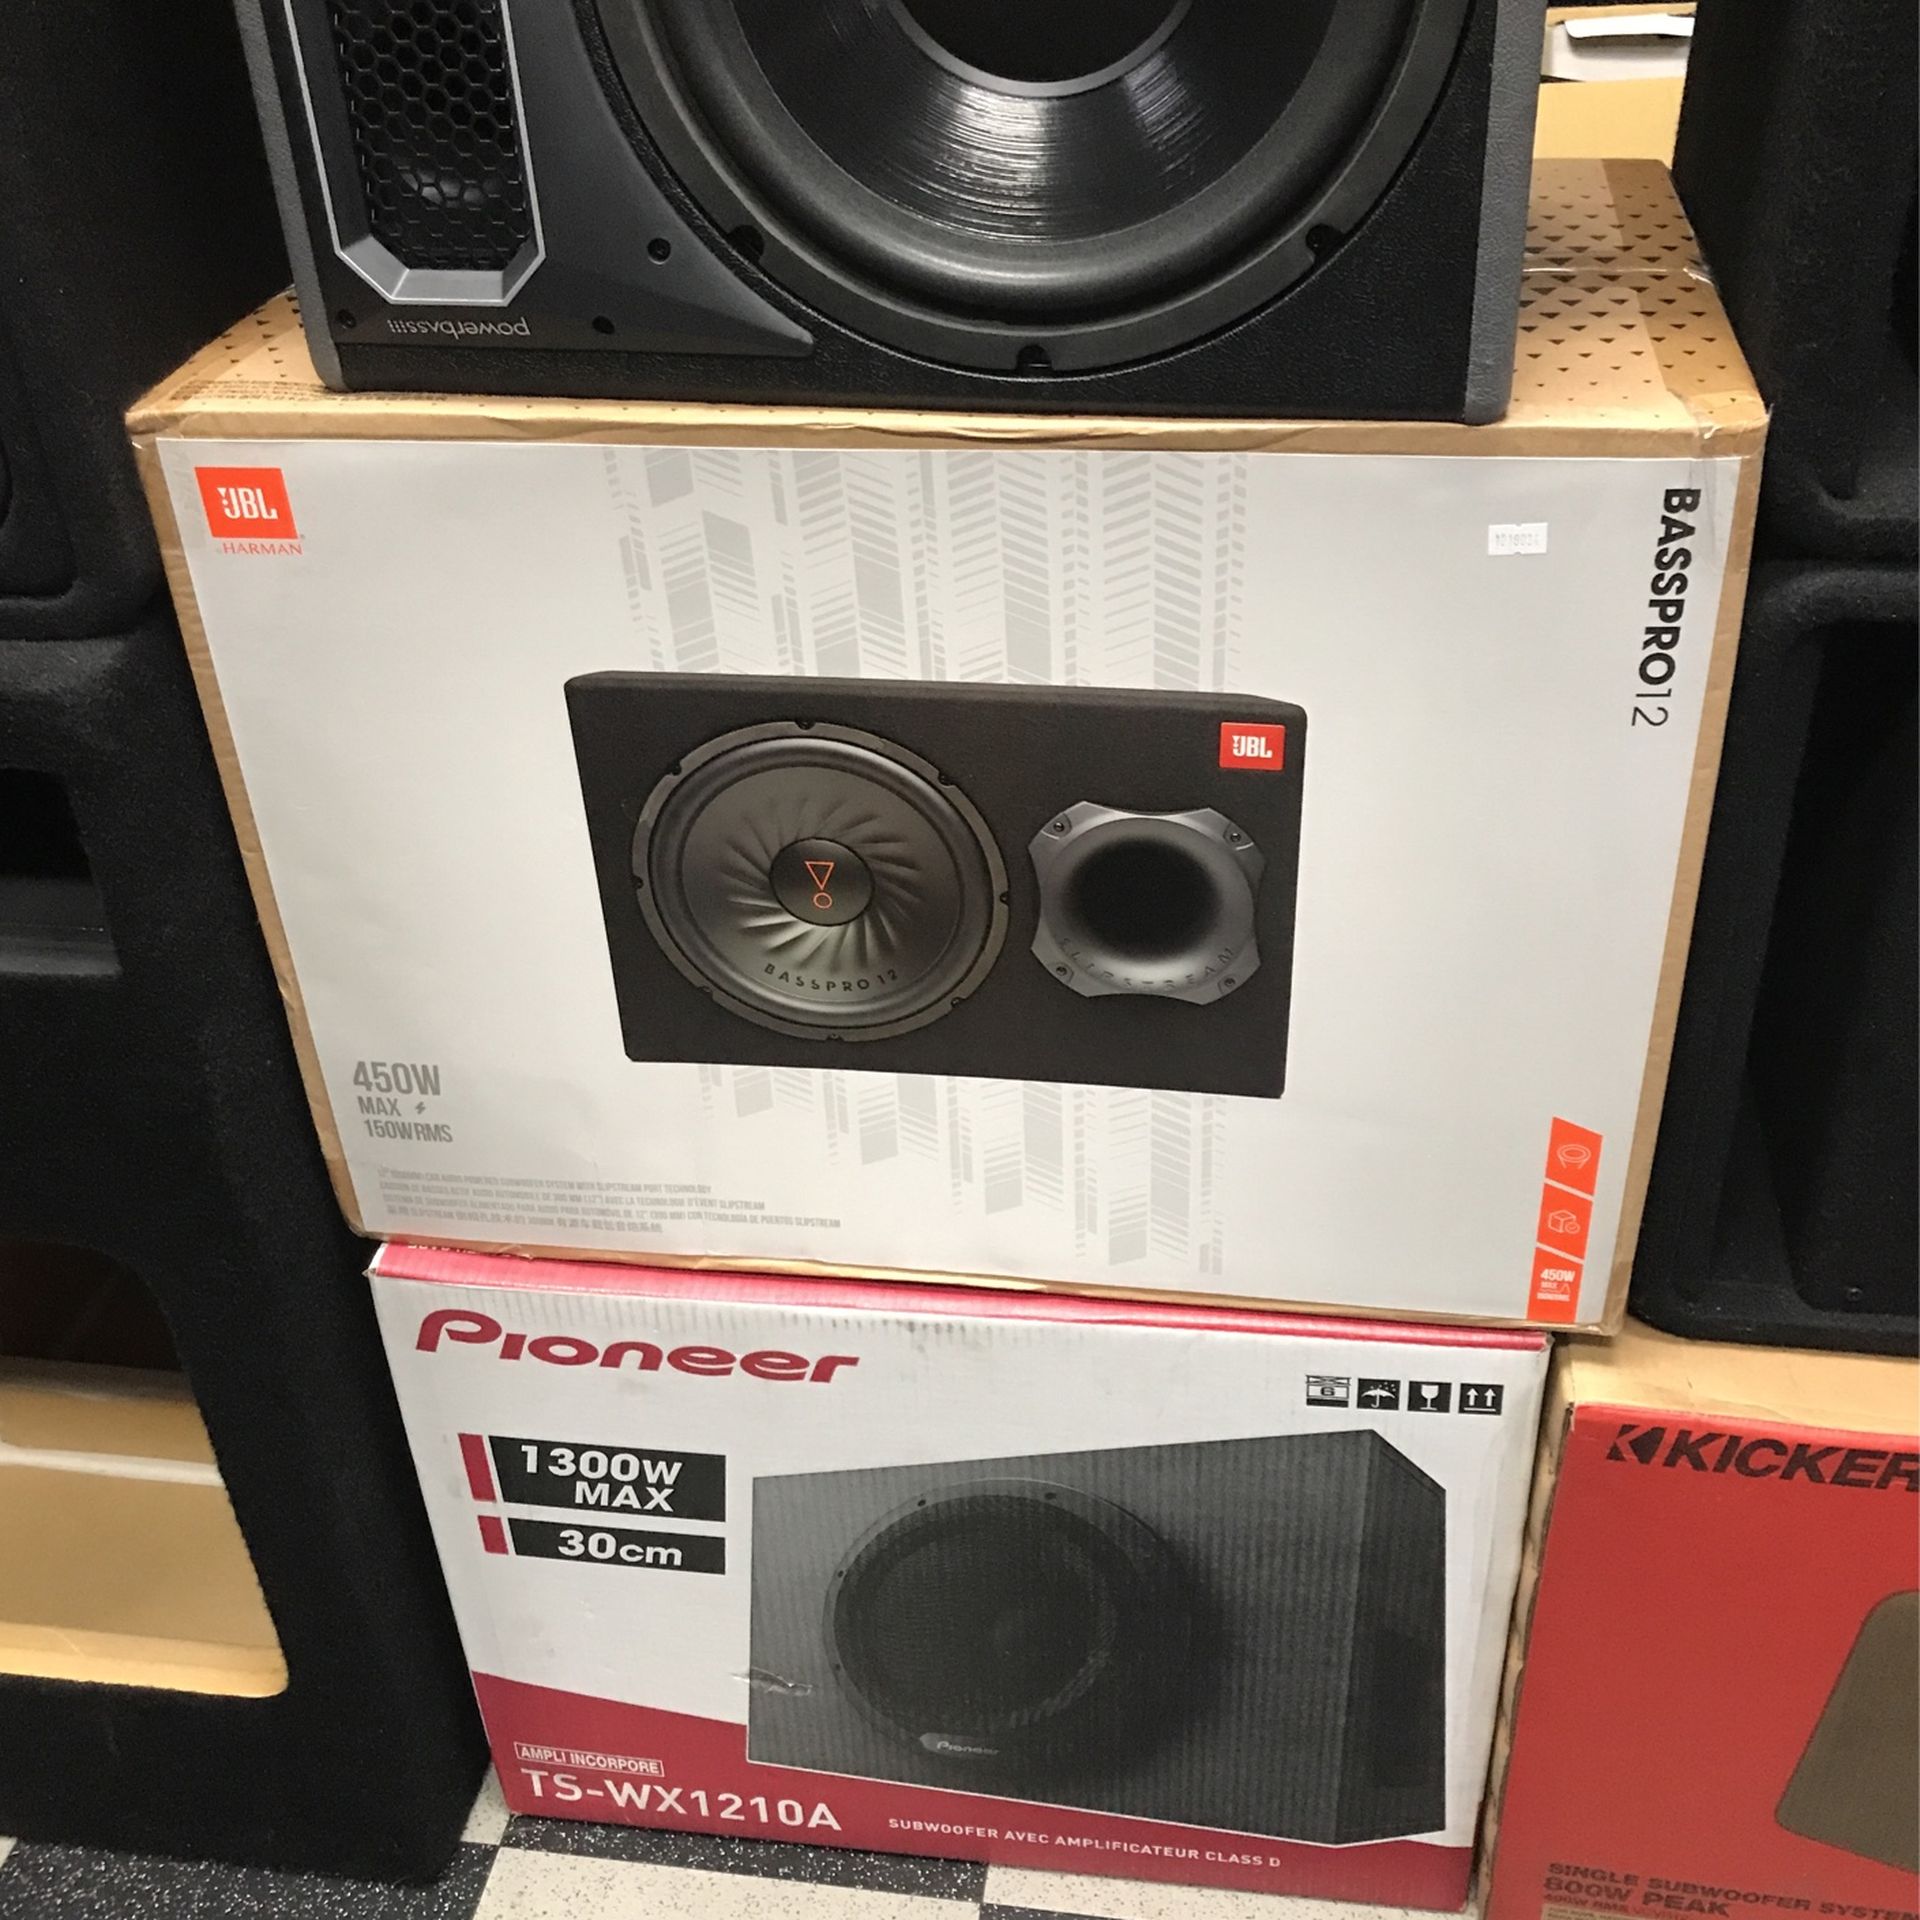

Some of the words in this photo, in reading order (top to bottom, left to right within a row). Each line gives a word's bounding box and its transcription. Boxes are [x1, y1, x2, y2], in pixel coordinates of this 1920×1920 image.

[217, 487, 279, 520] JBL
[222, 542, 303, 555] HARMAN
[1232, 735, 1273, 758] JBL
[353, 1061, 441, 1096] 450W
[357, 1096, 402, 1117] MAX
[1540, 1268, 1576, 1282] 450W
[415, 1308, 860, 1383] Pioneer
[521, 1445, 682, 1485] 1300W
[1662, 1429, 1919, 1493] KICKER
[574, 1480, 675, 1512] MAX
[557, 1529, 683, 1566] 30cm
[520, 1746, 567, 1764] AMPLI
[570, 1751, 661, 1774] INCORPORE
[520, 1768, 842, 1832] TS-WX1210A
[888, 1818, 999, 1839] SUBWOOFER
[1004, 1829, 1050, 1845] AVEC
[1054, 1835, 1201, 1860] AMPLIFICATEUR
[1205, 1850, 1263, 1867] CLASS
[1269, 1856, 1281, 1868] D
[1543, 1876, 1632, 1902] 800W
[1642, 1891, 1730, 1917] PEAK
[1547, 1862, 1639, 1887] SINGLE
[1648, 1877, 1811, 1911] SUBWOOFER
